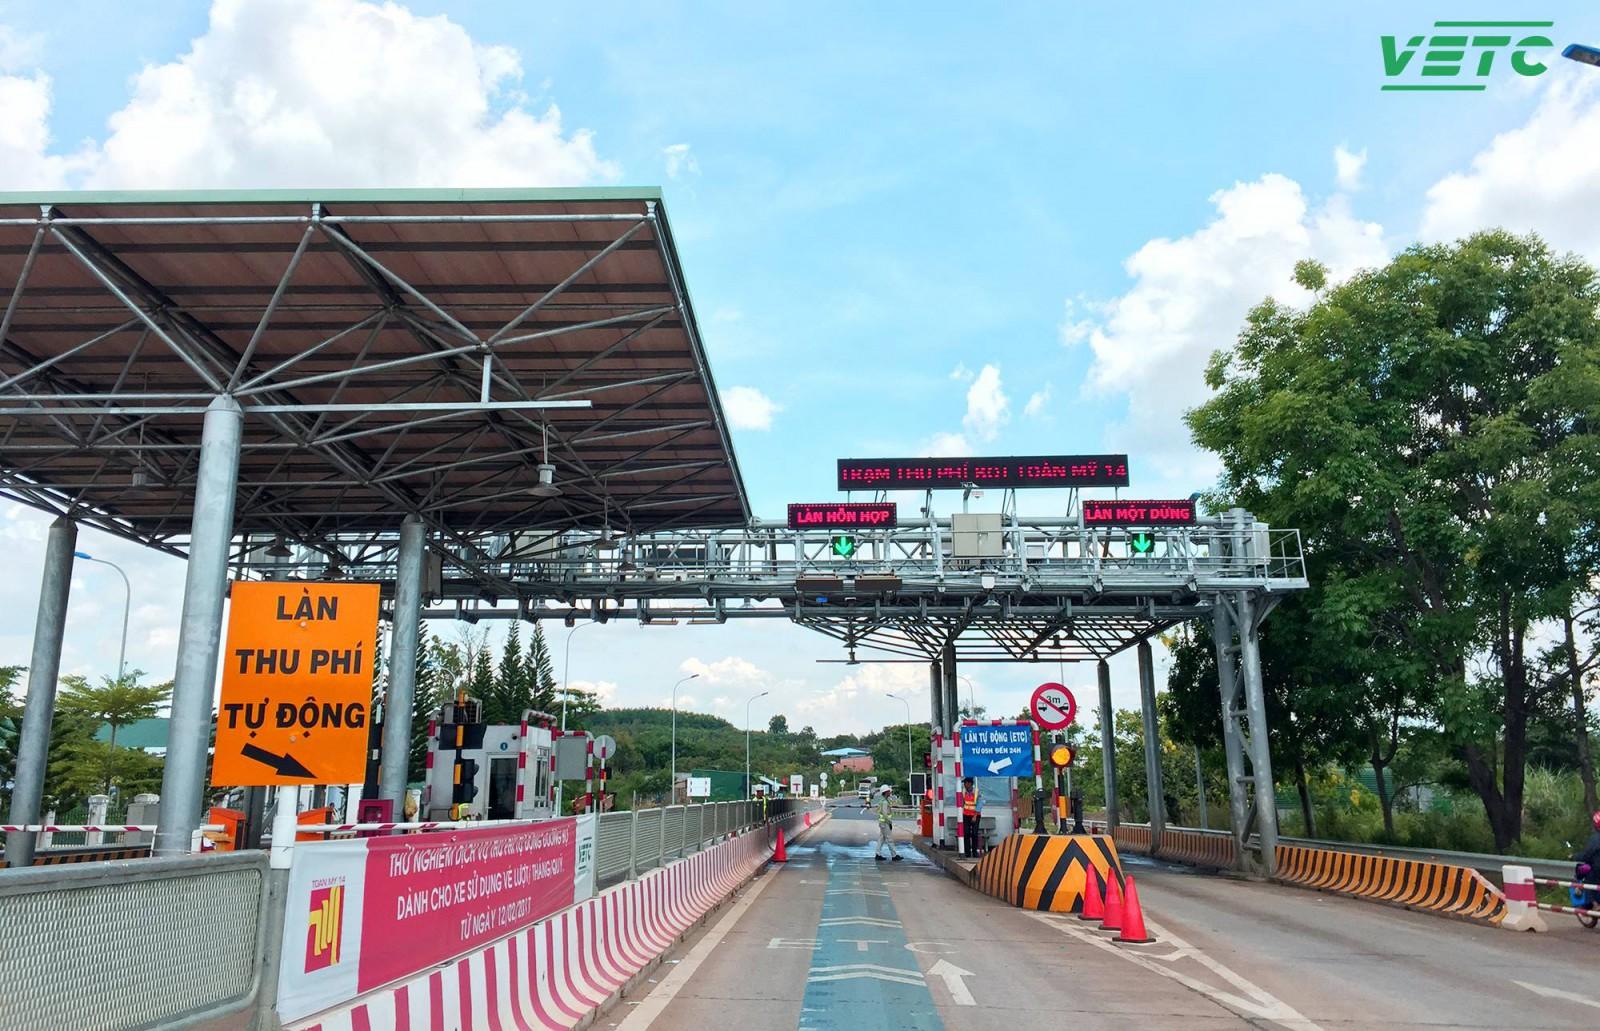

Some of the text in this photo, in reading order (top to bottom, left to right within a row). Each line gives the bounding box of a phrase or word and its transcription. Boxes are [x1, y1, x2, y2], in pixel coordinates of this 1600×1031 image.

[797, 507, 890, 524] LÀN HỖN HỢP
[1085, 504, 1112, 520] LÀN
[1116, 504, 1147, 521] MỘT
[276, 587, 338, 620] LÀN
[235, 641, 362, 675] THU PHÍ
[224, 696, 365, 738] TỰ ĐỘNG
[964, 730, 1028, 744] LÀN TỰ ĐỘNG (ETC)
[390, 843, 415, 877] THỬ
[413, 843, 456, 873] NGHIỆM
[455, 843, 477, 869] DỊCH
[397, 887, 429, 920] DÀNH
[430, 884, 452, 911] CHO
[453, 881, 466, 905] XE
[467, 869, 479, 901] SỬ
[479, 872, 502, 899] DỤNG
[503, 865, 513, 889] VÉ
[461, 912, 473, 941] TỪ
[472, 905, 497, 936] NGÀY
